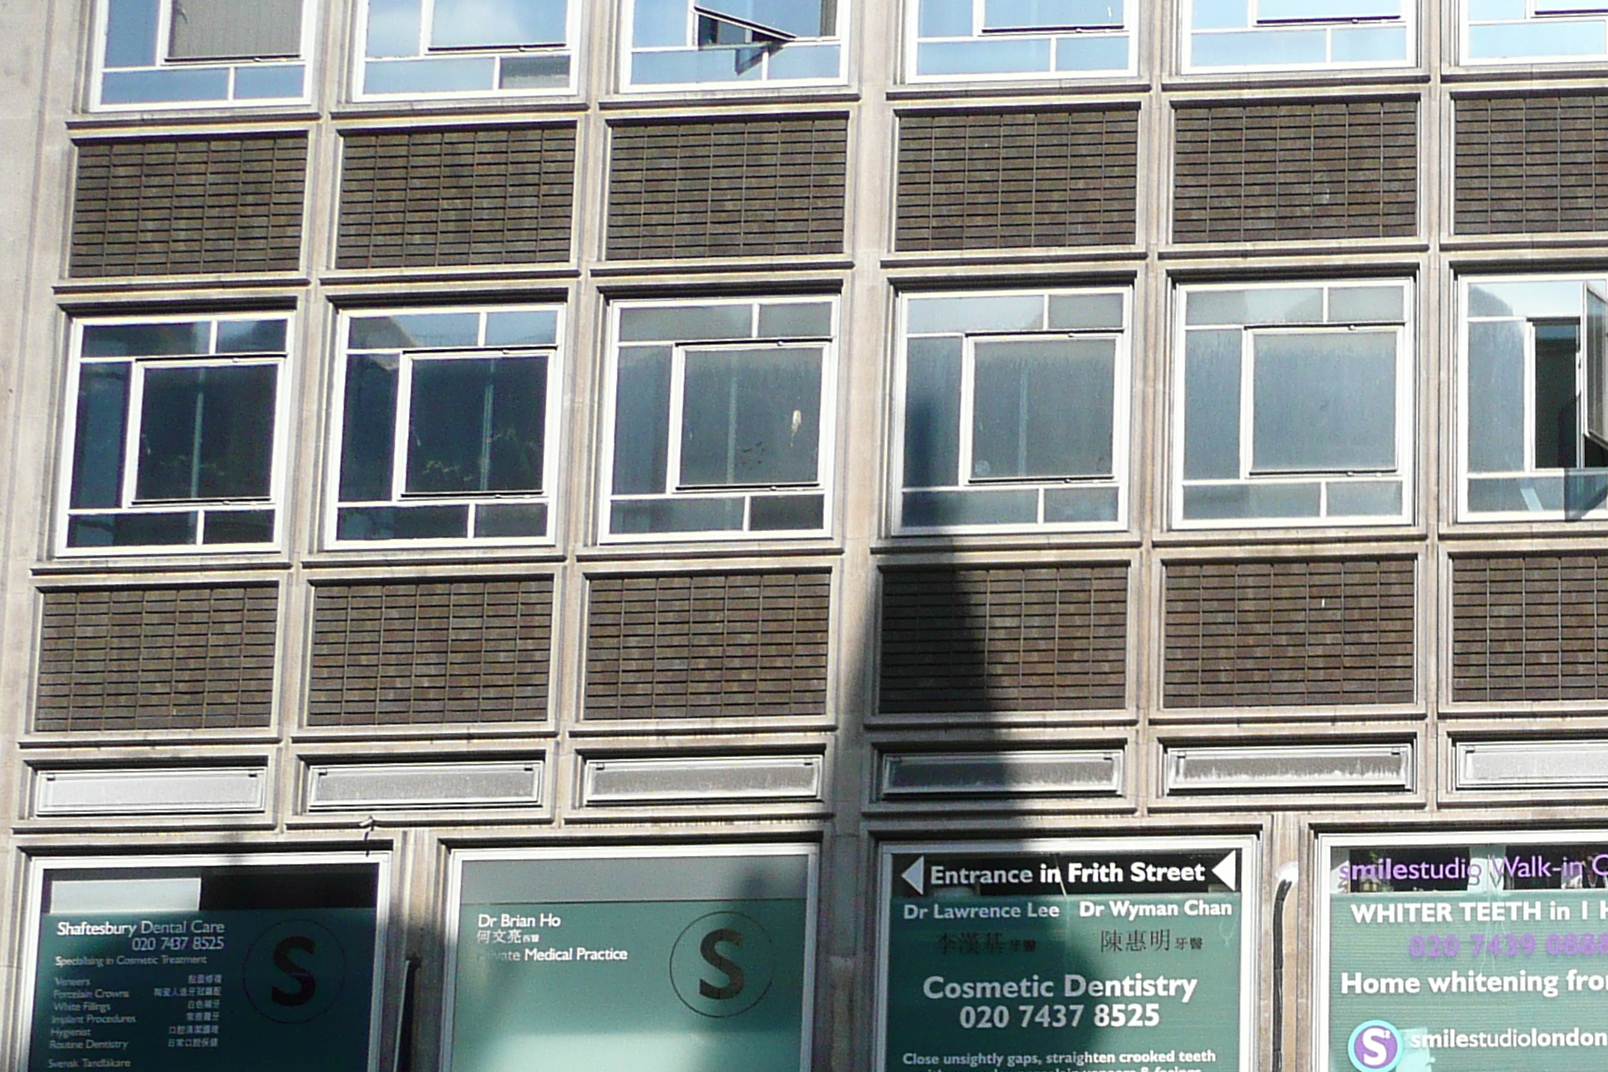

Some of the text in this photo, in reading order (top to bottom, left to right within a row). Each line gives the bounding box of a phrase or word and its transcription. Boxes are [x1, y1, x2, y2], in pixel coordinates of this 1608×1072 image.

[930, 860, 1206, 885] Entrance in Frith Street
[1339, 855, 1482, 881] smilestudio
[1492, 854, 1583, 879] Walk-in
[478, 913, 561, 928] Dr Brian Ho
[904, 903, 1060, 920] Dr Lawrence Lee
[1080, 899, 1233, 922] Dr Wyman Chan
[1351, 902, 1452, 924] WHITER
[1459, 901, 1541, 922] TEETH
[1550, 900, 1570, 920] in
[57, 919, 225, 937] Shaftesbury Dental Care
[132, 936, 225, 951] 020 7437 8525
[525, 947, 572, 961] Medical
[577, 947, 628, 961] Practice
[1409, 934, 1460, 959] 020
[1470, 933, 1536, 957] 7439
[116, 955, 158, 965] Cosmetic
[161, 955, 207, 965] Treatment
[271, 935, 317, 1007] S
[699, 928, 746, 1000] S
[923, 973, 1198, 1003] Cosmetic Dentistry
[1341, 971, 1420, 994] Home
[1428, 970, 1559, 997] whitening
[86, 1014, 136, 1023] Procedures
[960, 1003, 1160, 1029] 020 7437 8525
[50, 1040, 129, 1050] Routine Dentistry
[903, 1050, 1216, 1068] Close unsightly gaps, straighten crooked teeth
